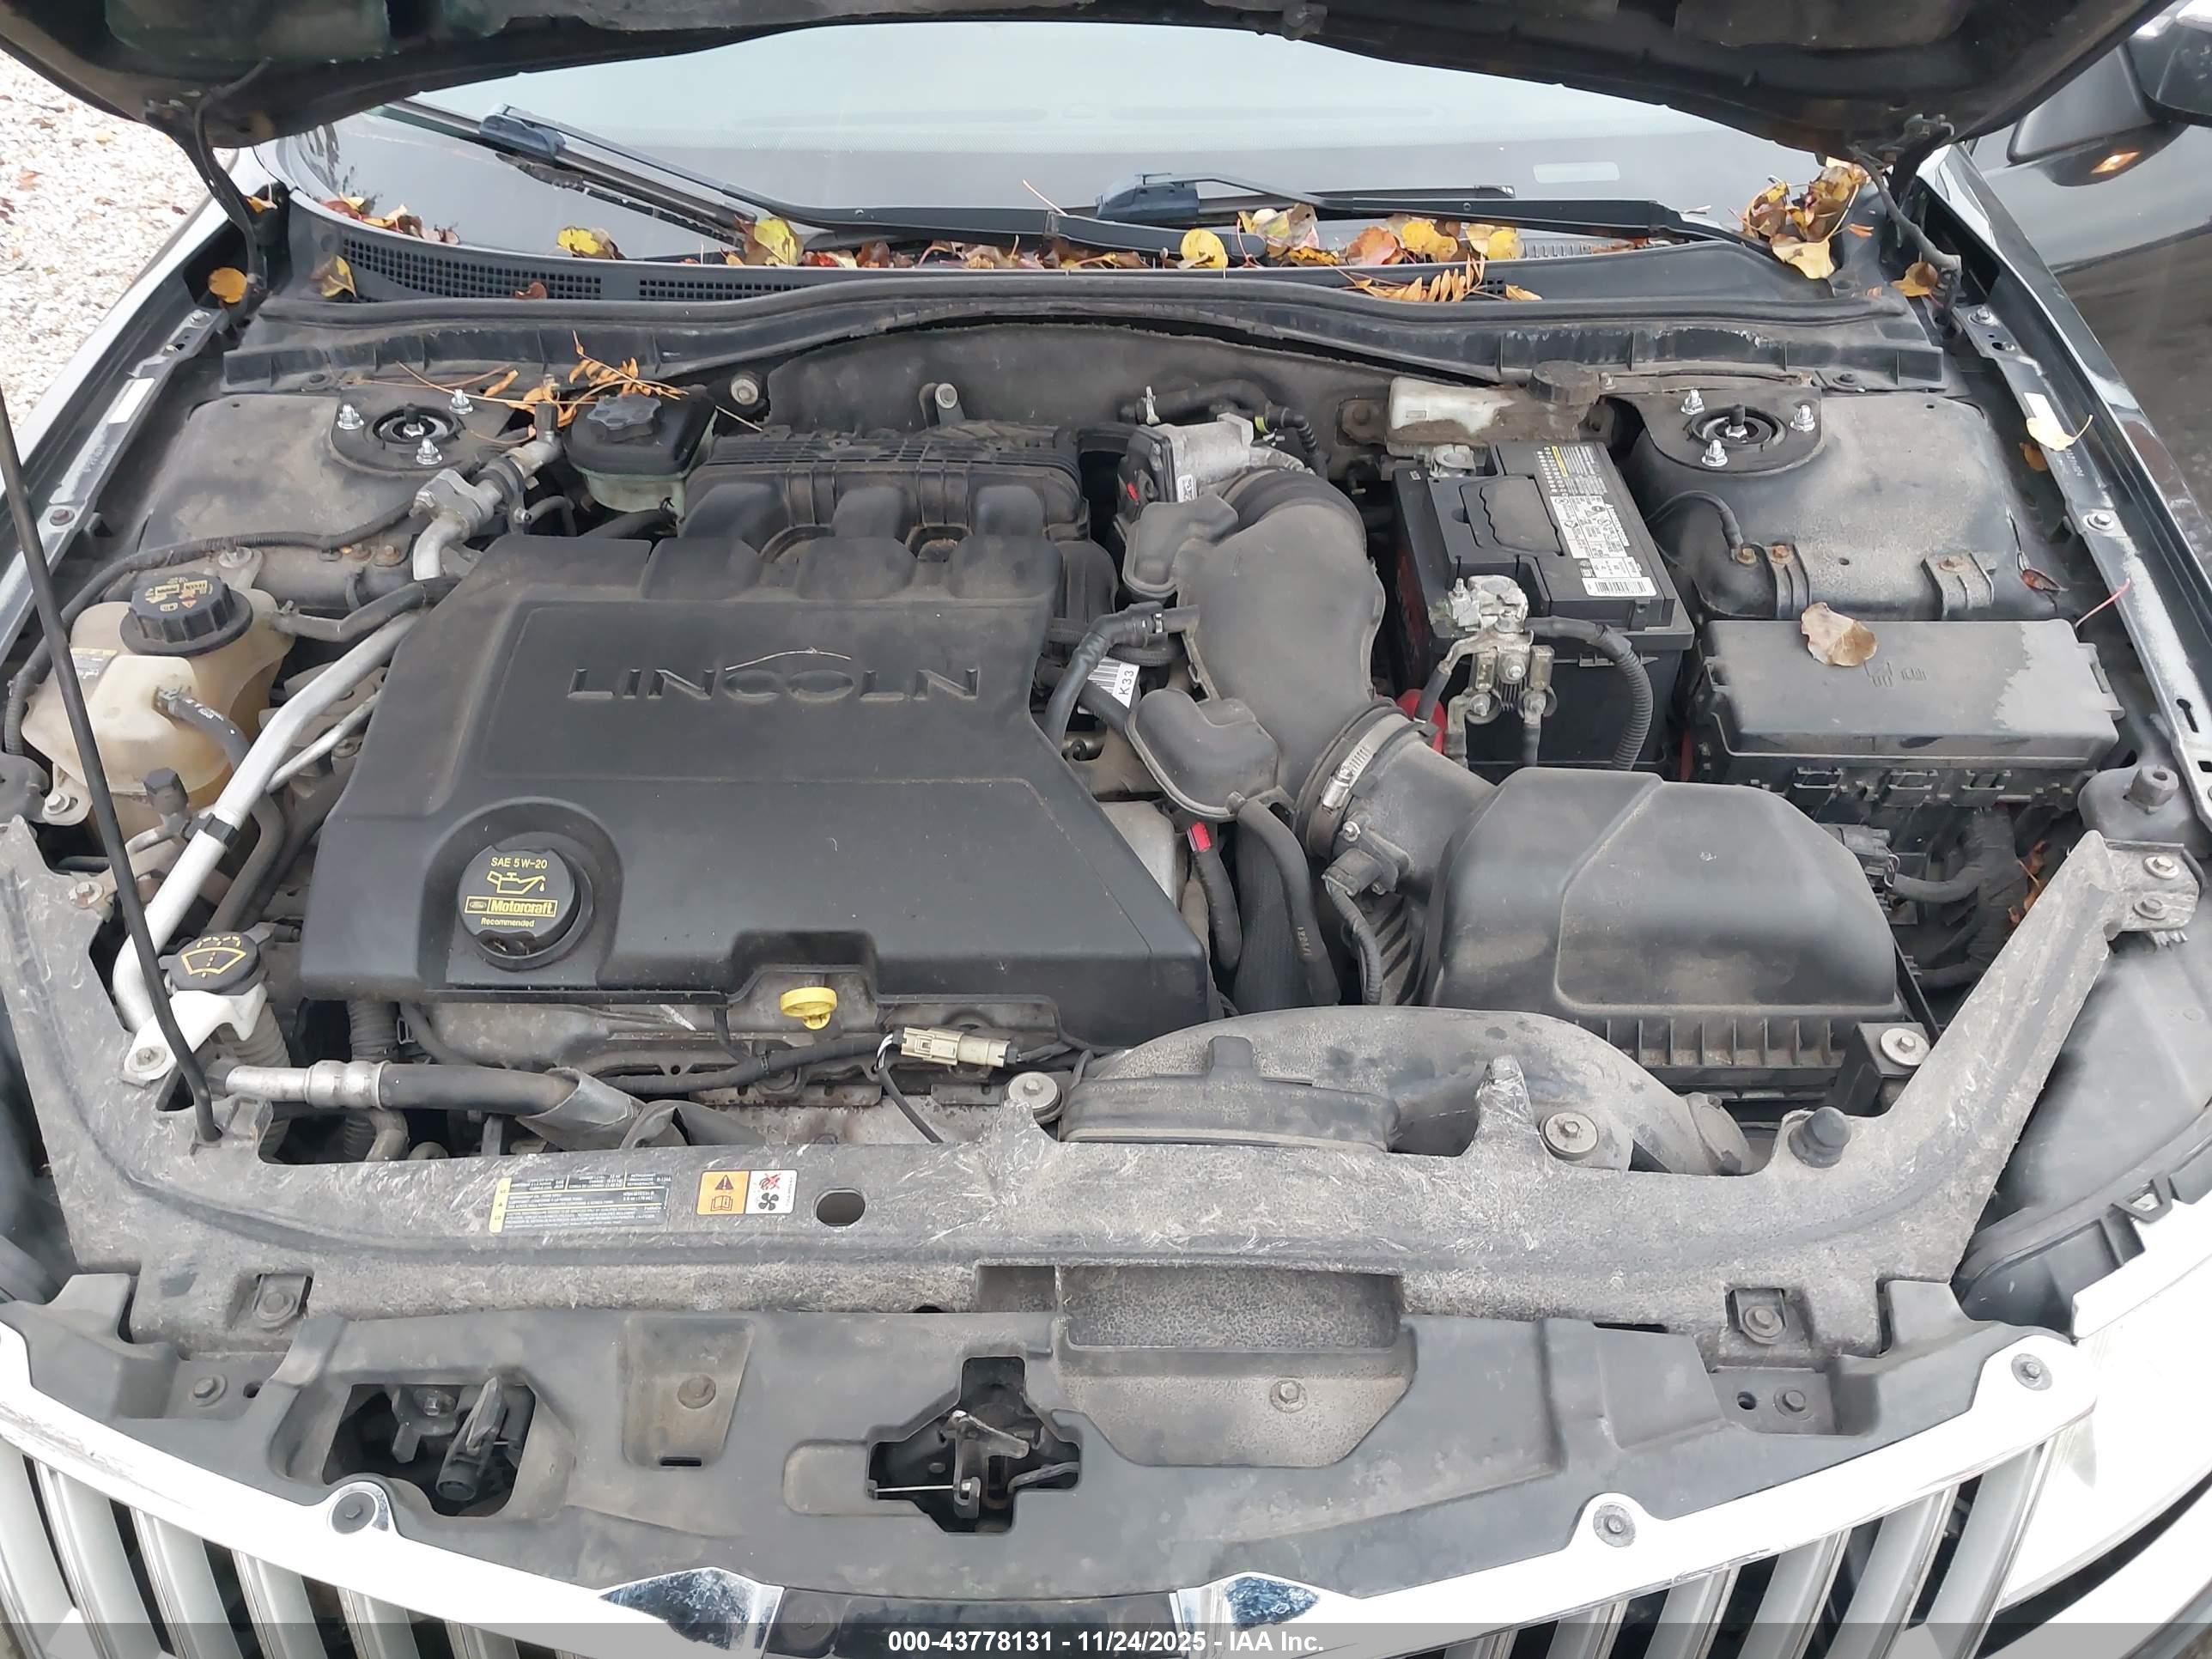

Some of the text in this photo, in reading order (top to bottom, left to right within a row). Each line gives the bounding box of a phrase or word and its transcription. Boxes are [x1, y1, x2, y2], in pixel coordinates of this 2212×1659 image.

[568, 668, 979, 702] LINCOLN
[1118, 670, 1134, 696] K33
[490, 857, 511, 868] SAE
[490, 899, 552, 915] Motorcraft
[480, 917, 536, 927] Recommended
